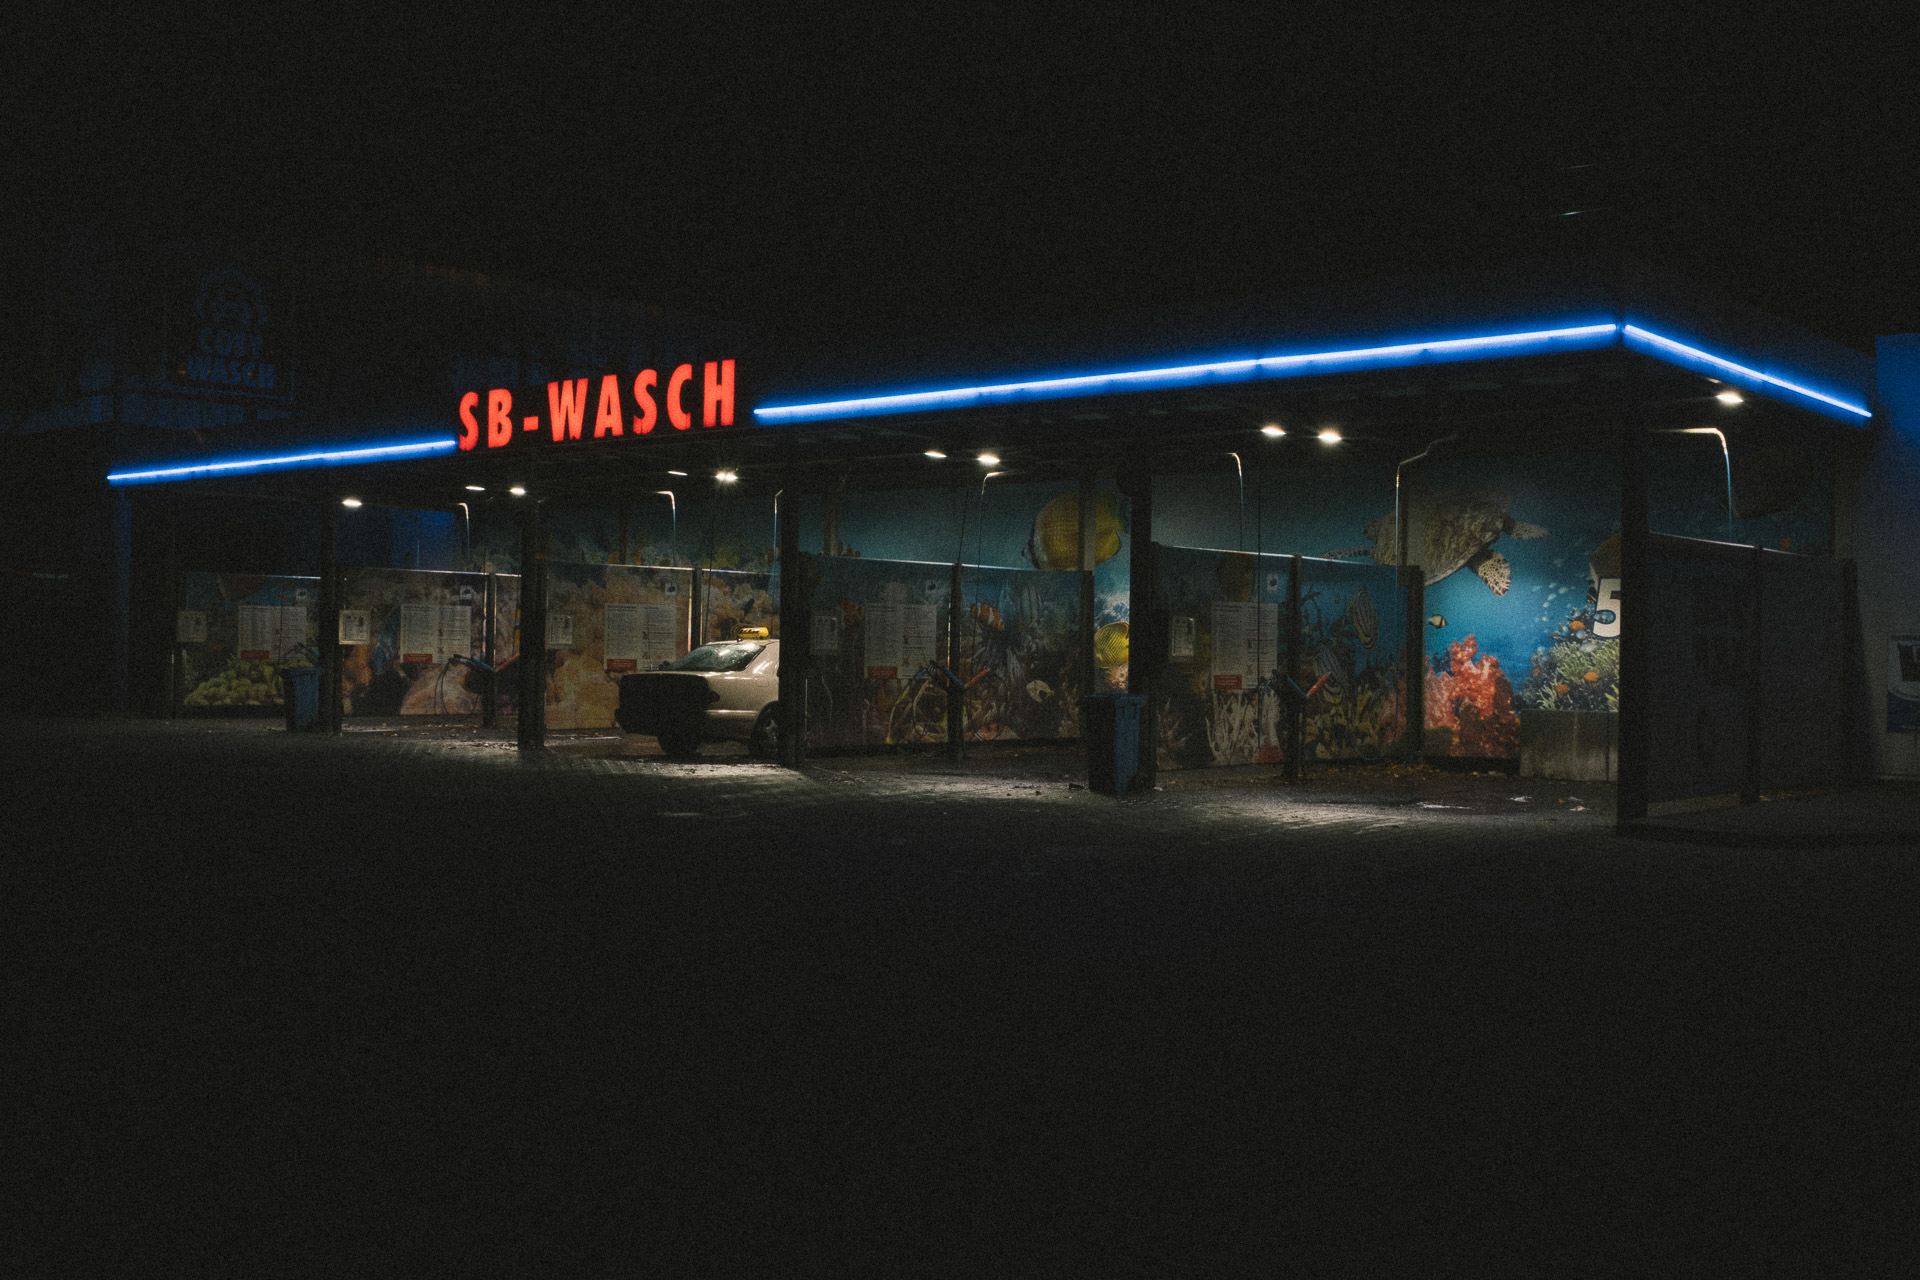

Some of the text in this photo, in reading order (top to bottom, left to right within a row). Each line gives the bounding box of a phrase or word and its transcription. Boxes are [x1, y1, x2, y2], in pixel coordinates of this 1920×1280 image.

[199, 327, 264, 360] COSY
[186, 354, 275, 390] WASCH
[459, 359, 735, 450] SB-WASCH
[1593, 578, 1621, 638] 5
